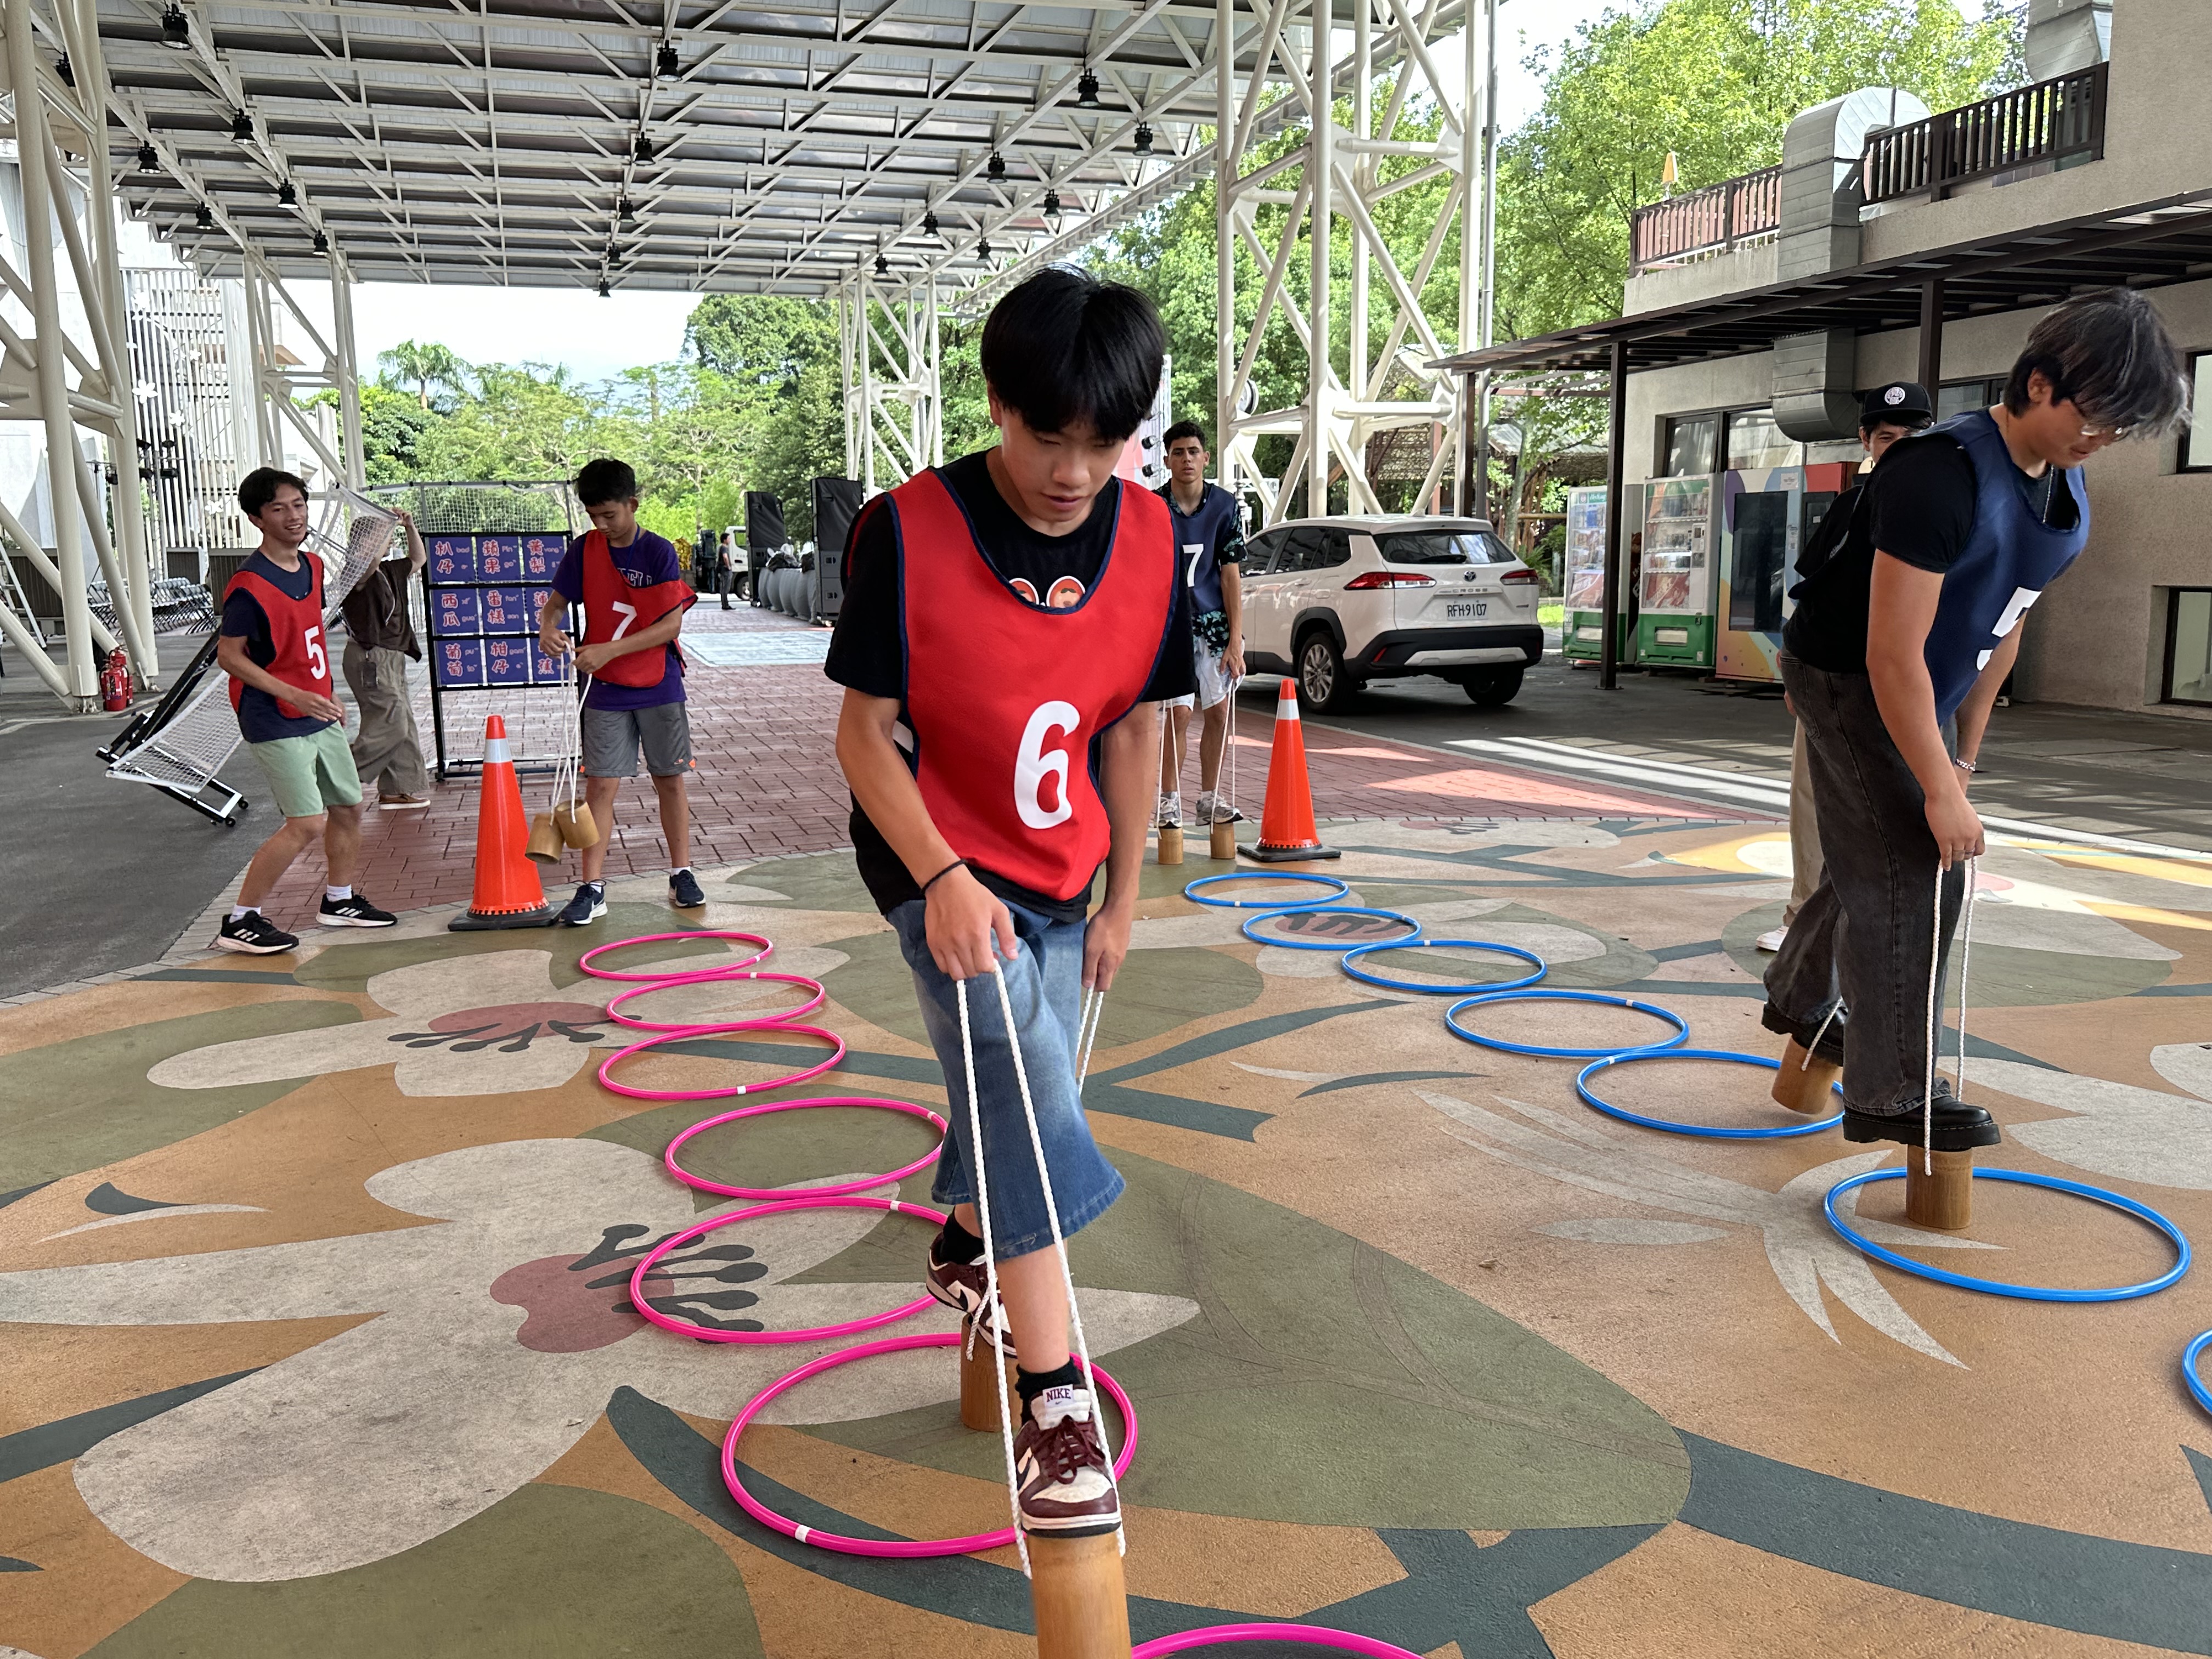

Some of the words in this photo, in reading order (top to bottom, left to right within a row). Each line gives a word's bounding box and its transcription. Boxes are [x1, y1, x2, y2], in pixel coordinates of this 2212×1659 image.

[482, 539, 500, 574] 蘋果
[527, 538, 546, 574] 黃梨
[1182, 543, 1204, 588] 7
[442, 593, 460, 627] 西瓜
[611, 601, 637, 641] 7
[1447, 603, 1487, 618] RFH-9107
[304, 625, 326, 680] 5
[445, 643, 463, 676] 葡萄
[490, 641, 509, 674] 柑仔
[1014, 700, 1081, 830] 6
[1046, 1387, 1071, 1402] NIKE
